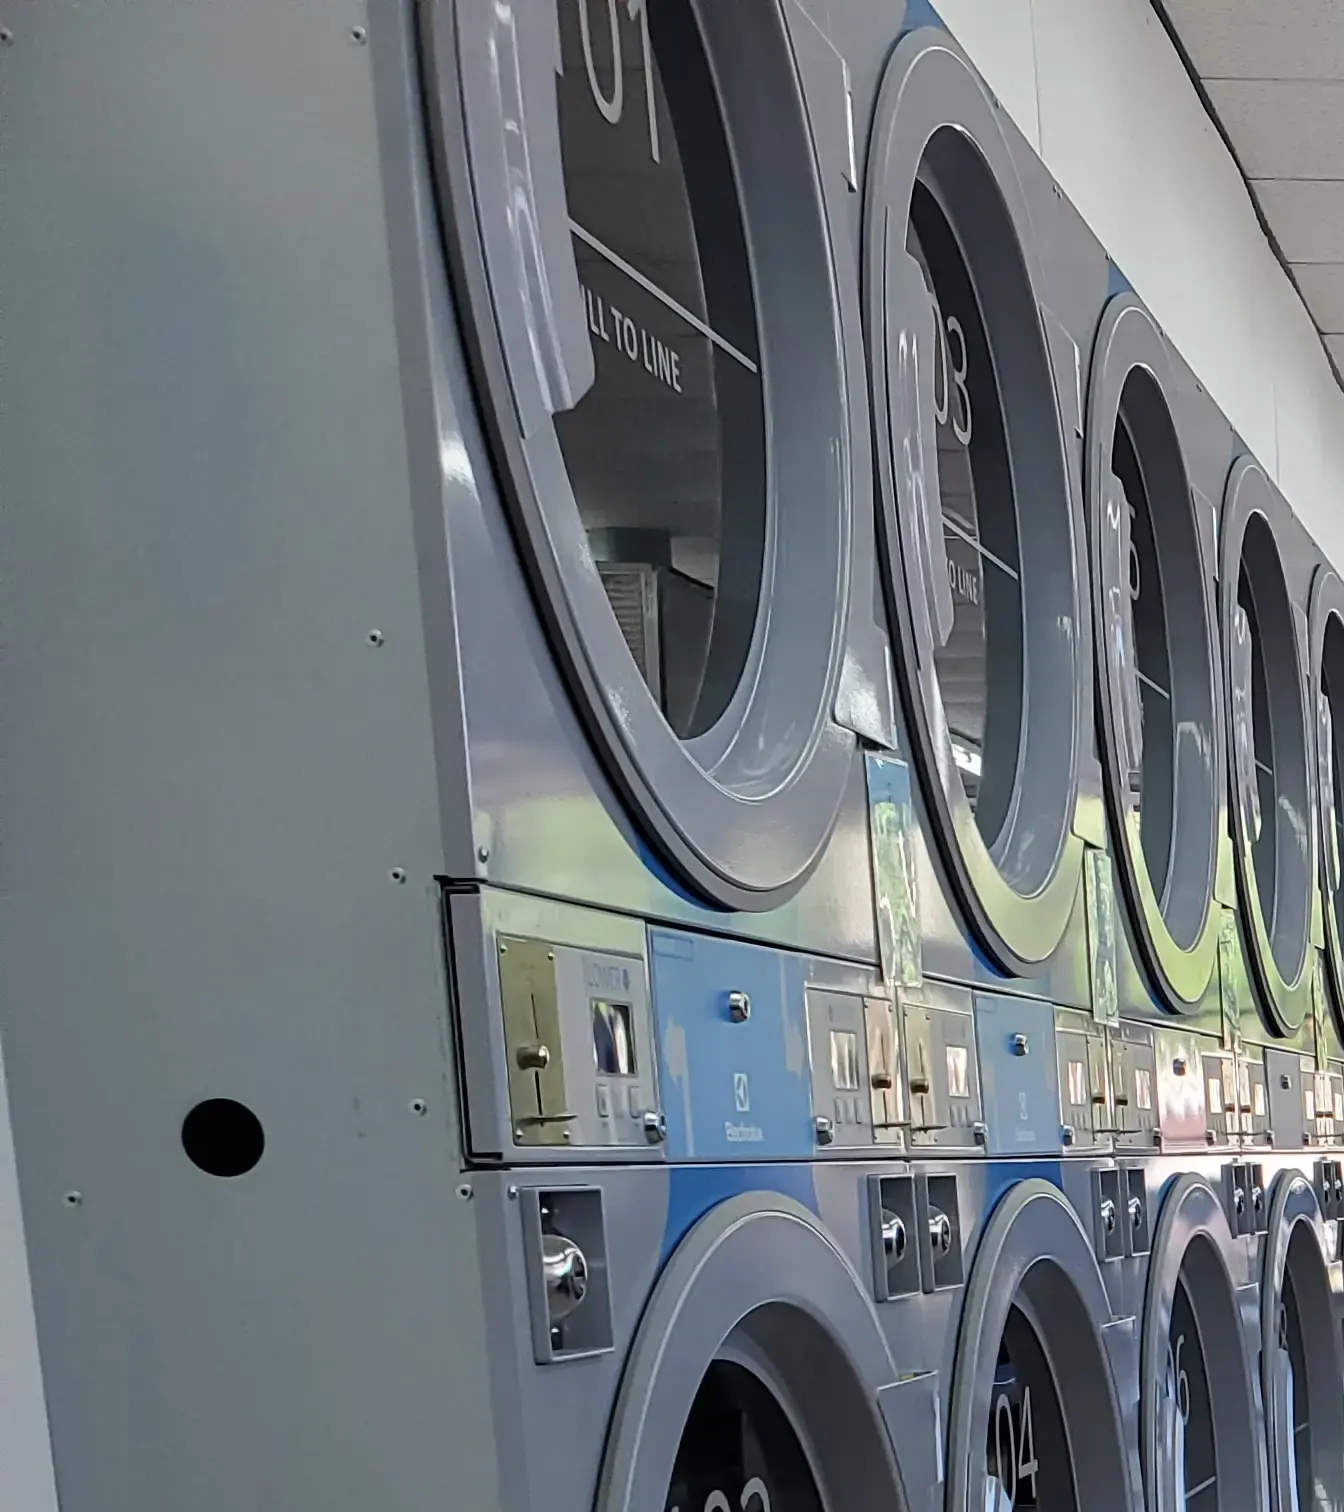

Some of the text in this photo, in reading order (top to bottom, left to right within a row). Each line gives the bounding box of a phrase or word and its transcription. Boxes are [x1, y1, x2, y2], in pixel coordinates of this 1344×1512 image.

[610, 305, 638, 361] TO
[642, 328, 683, 394] LINE
[957, 566, 978, 605] LINE
